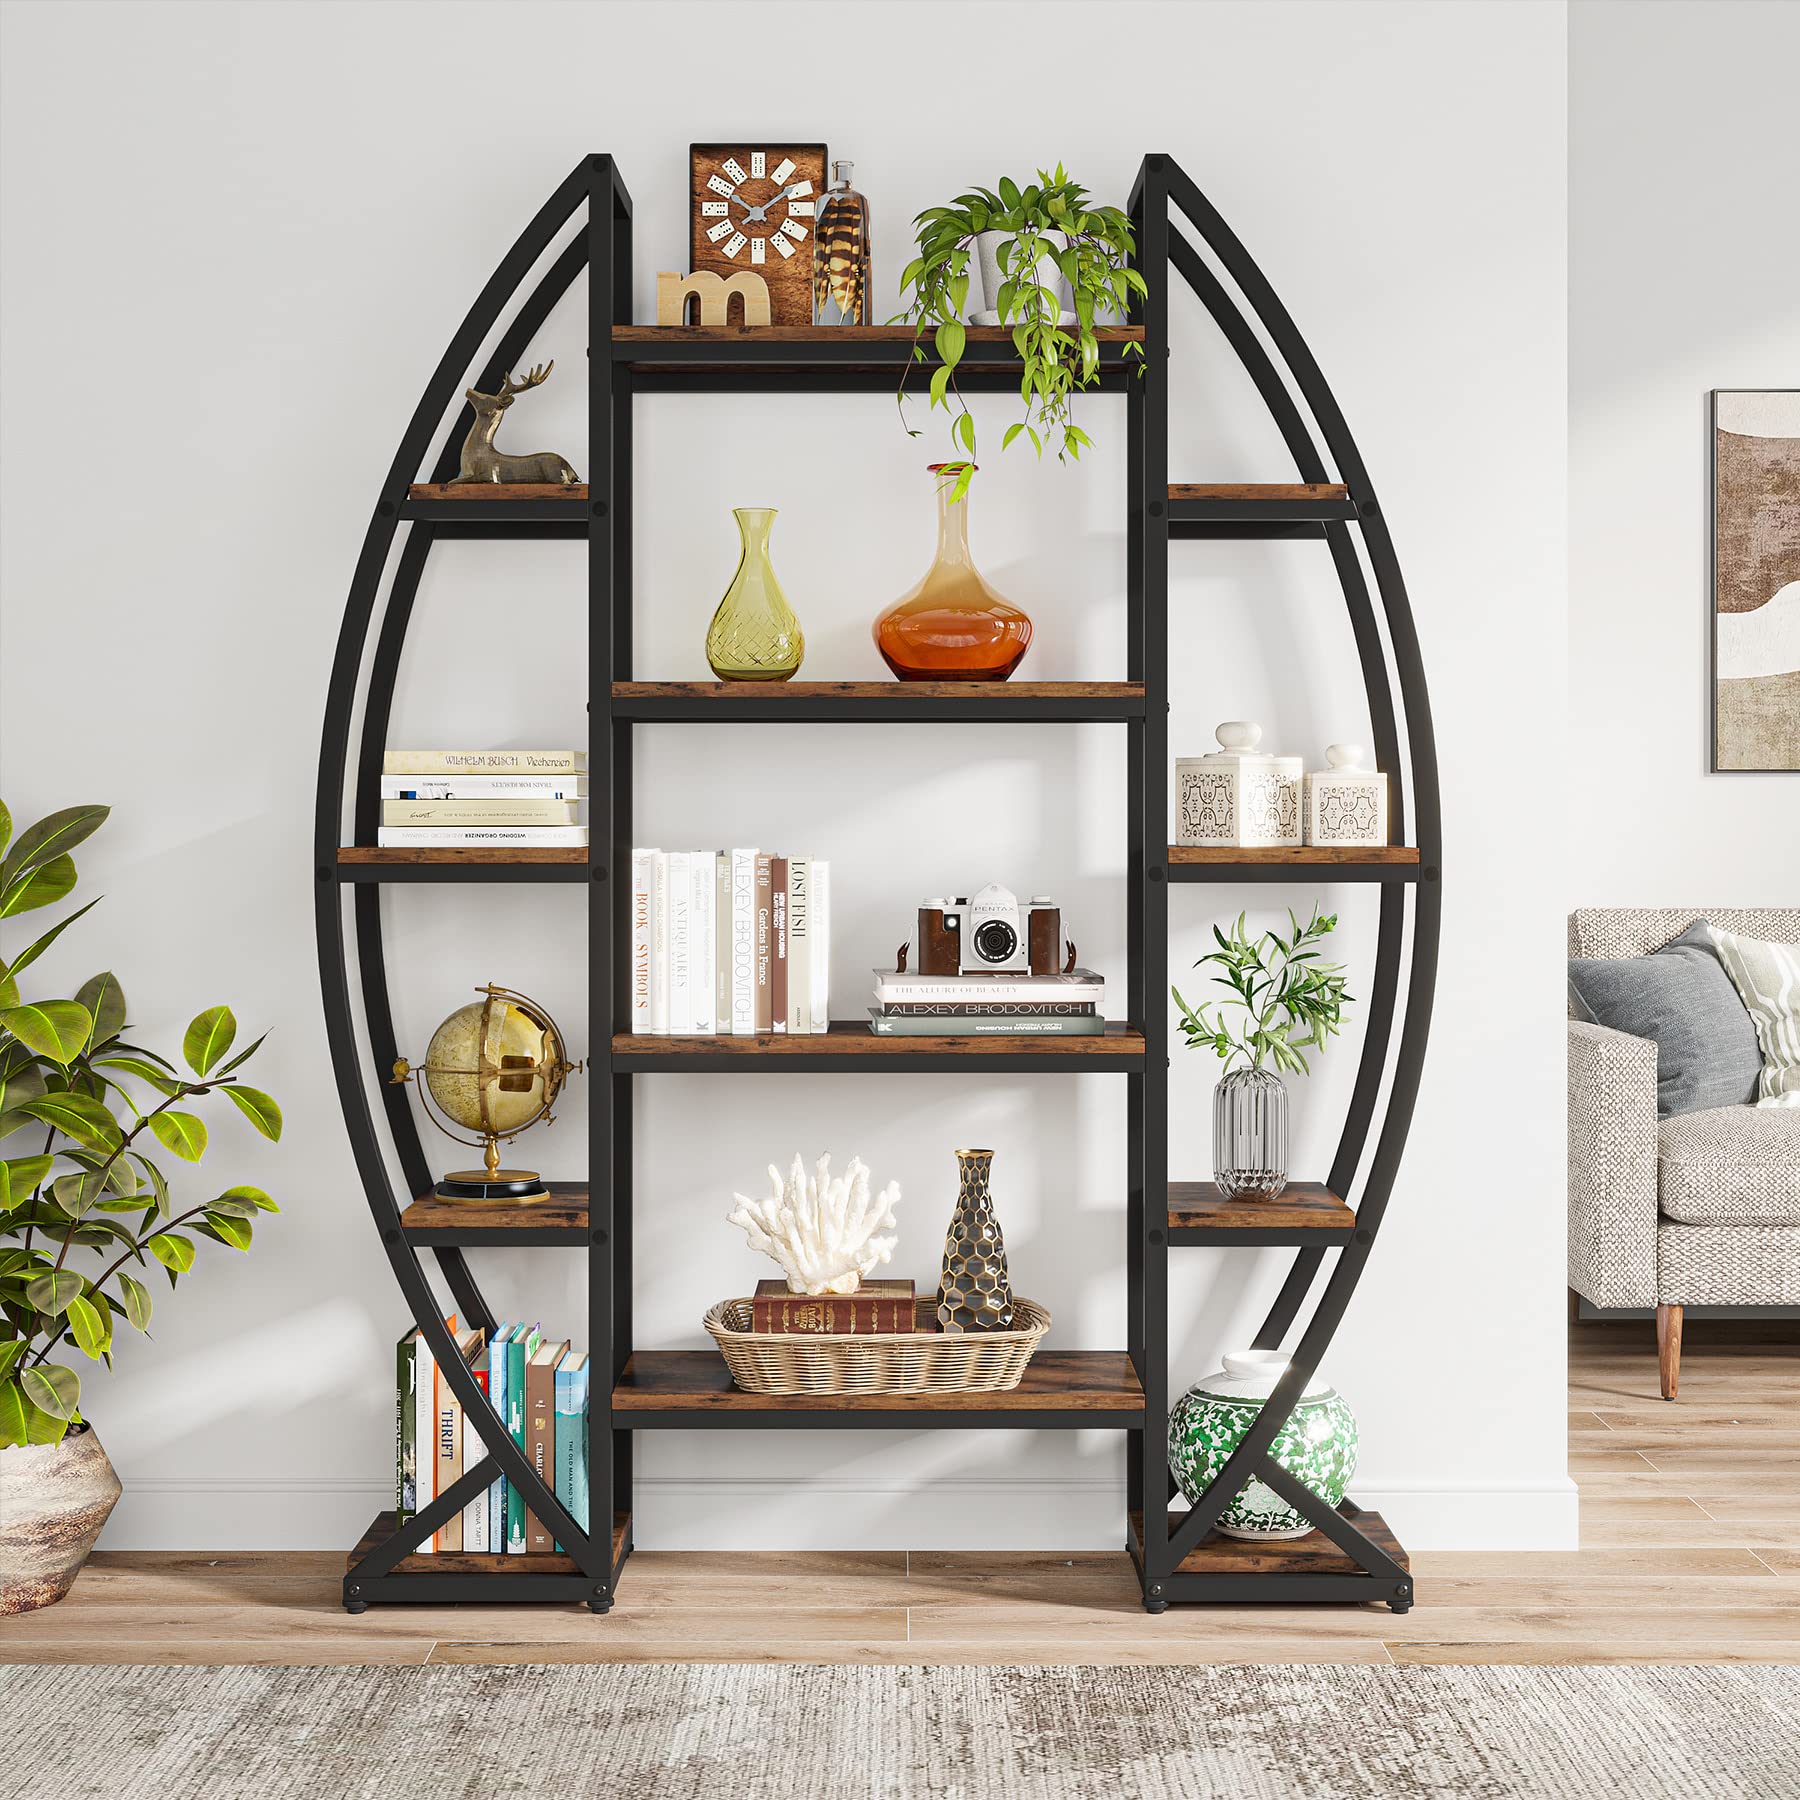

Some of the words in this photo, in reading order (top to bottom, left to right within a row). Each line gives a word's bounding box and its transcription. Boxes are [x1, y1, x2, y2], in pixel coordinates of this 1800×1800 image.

[656, 270, 771, 327] m
[445, 755, 485, 766] WILHELM
[487, 755, 518, 766] BUSCH
[735, 854, 751, 915] ALEXEY
[791, 862, 806, 901] LOST
[634, 892, 649, 930] BOOK
[758, 908, 768, 944] Gardens
[791, 905, 806, 937] FISH
[675, 898, 688, 989] ANTIQUAIRES
[758, 945, 768, 954] in
[634, 943, 649, 1009] SYMBOLS
[735, 920, 751, 1022] BRODOVITCH
[758, 956, 768, 986] France
[889, 1004, 959, 1014] ALEXEY
[965, 1004, 1082, 1014] BRODOVITCH
[440, 1409, 454, 1460] THRIFT
[535, 1442, 543, 1477] CHARLO
